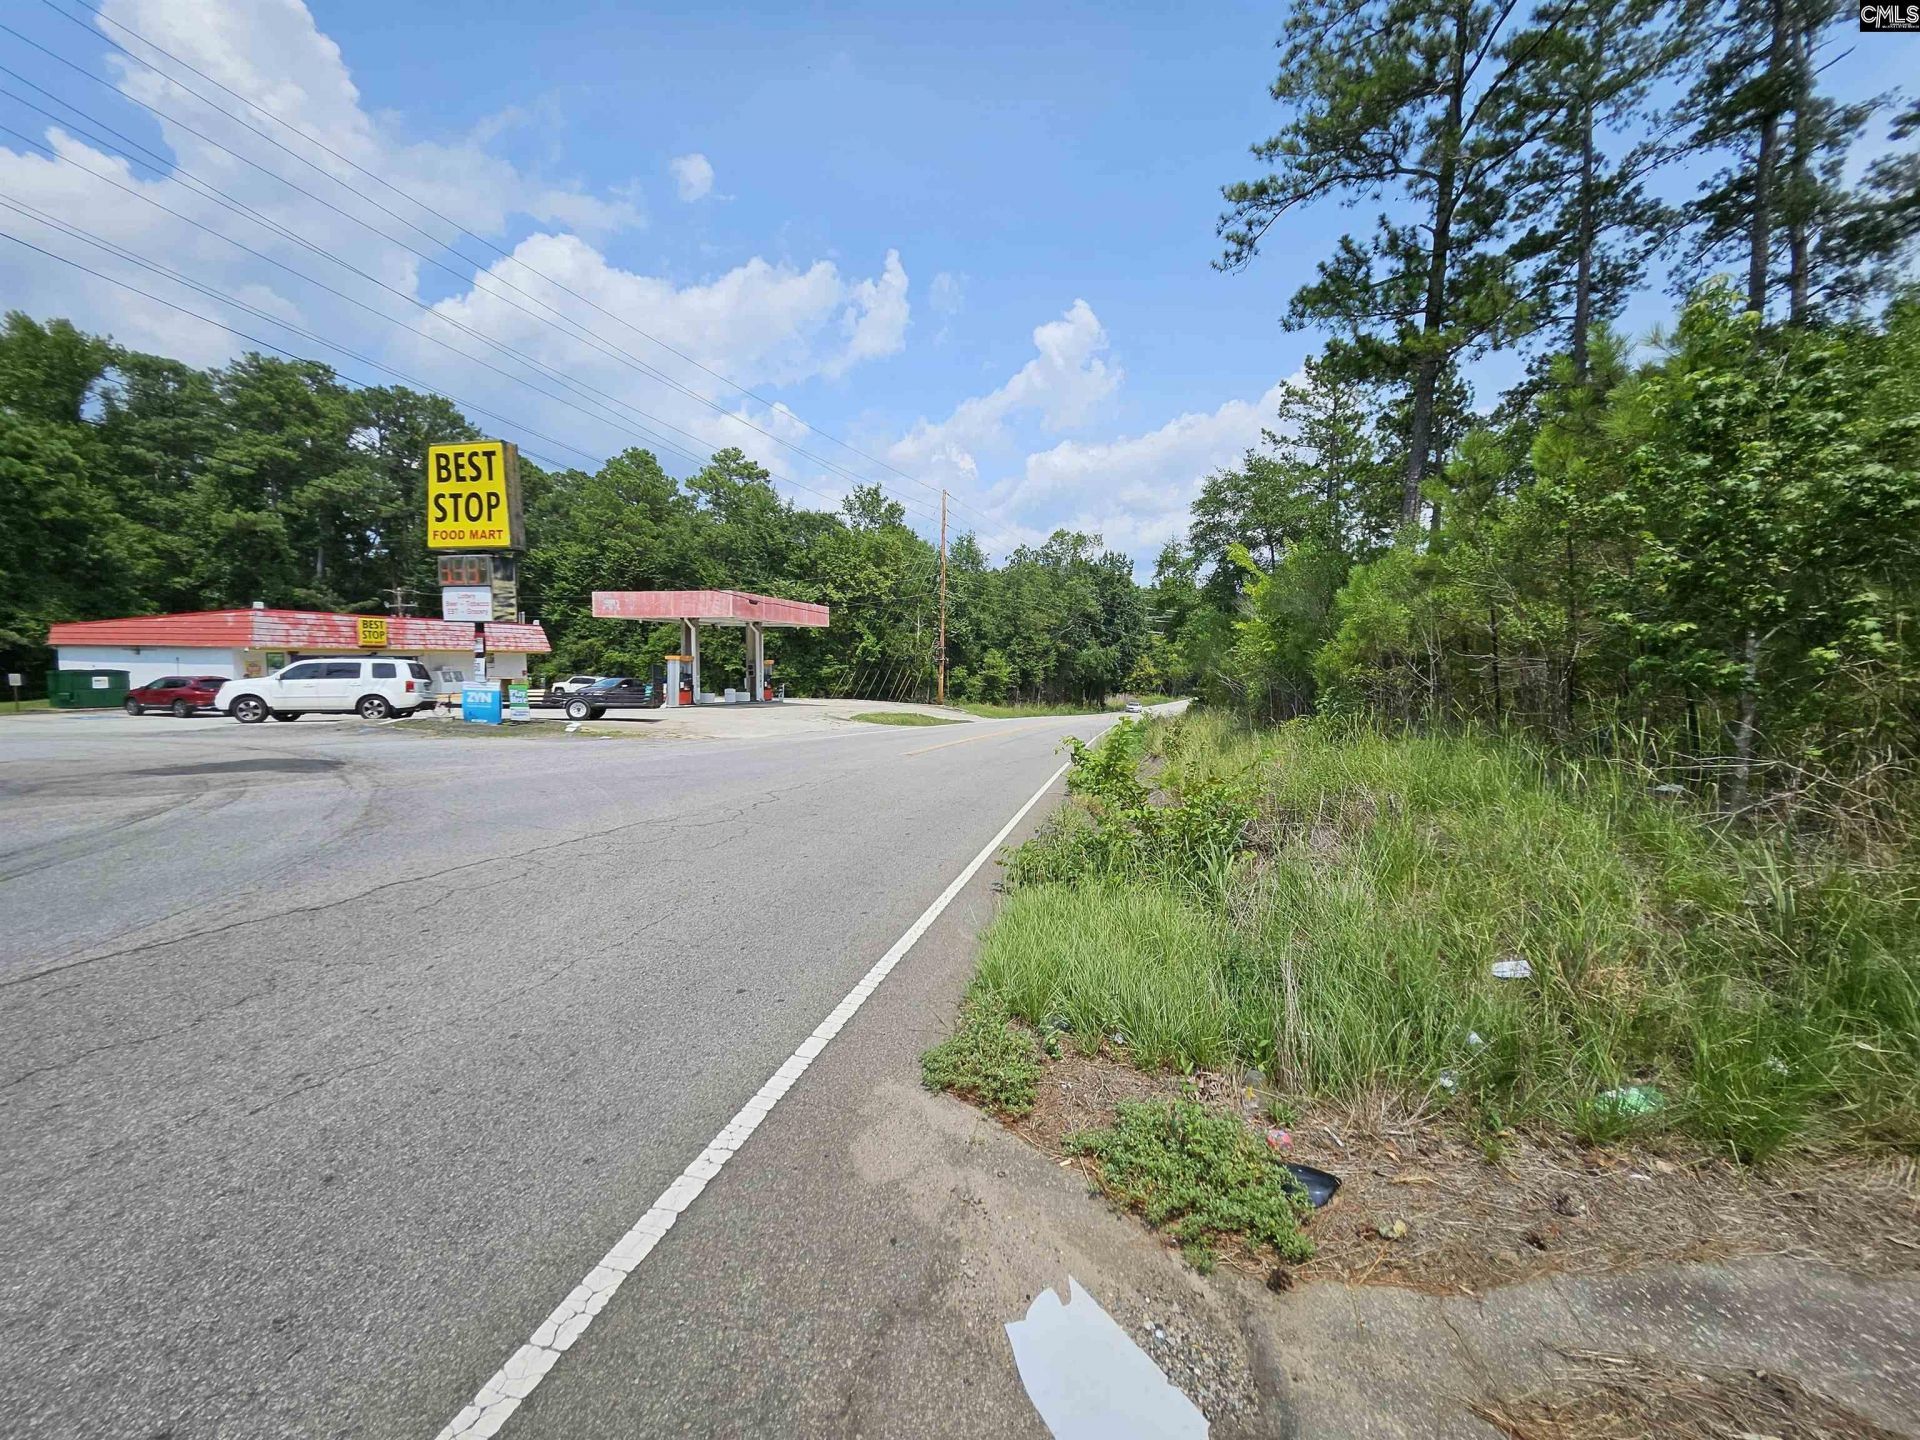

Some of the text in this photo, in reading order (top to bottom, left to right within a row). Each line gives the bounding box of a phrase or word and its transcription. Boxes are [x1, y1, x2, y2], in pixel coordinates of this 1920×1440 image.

[435, 450, 496, 482] BEST
[433, 491, 500, 523] STOP
[433, 529, 503, 540] FOOD MART
[362, 620, 384, 629] BEST
[362, 630, 385, 640] STOP
[466, 692, 492, 703] ZYN
